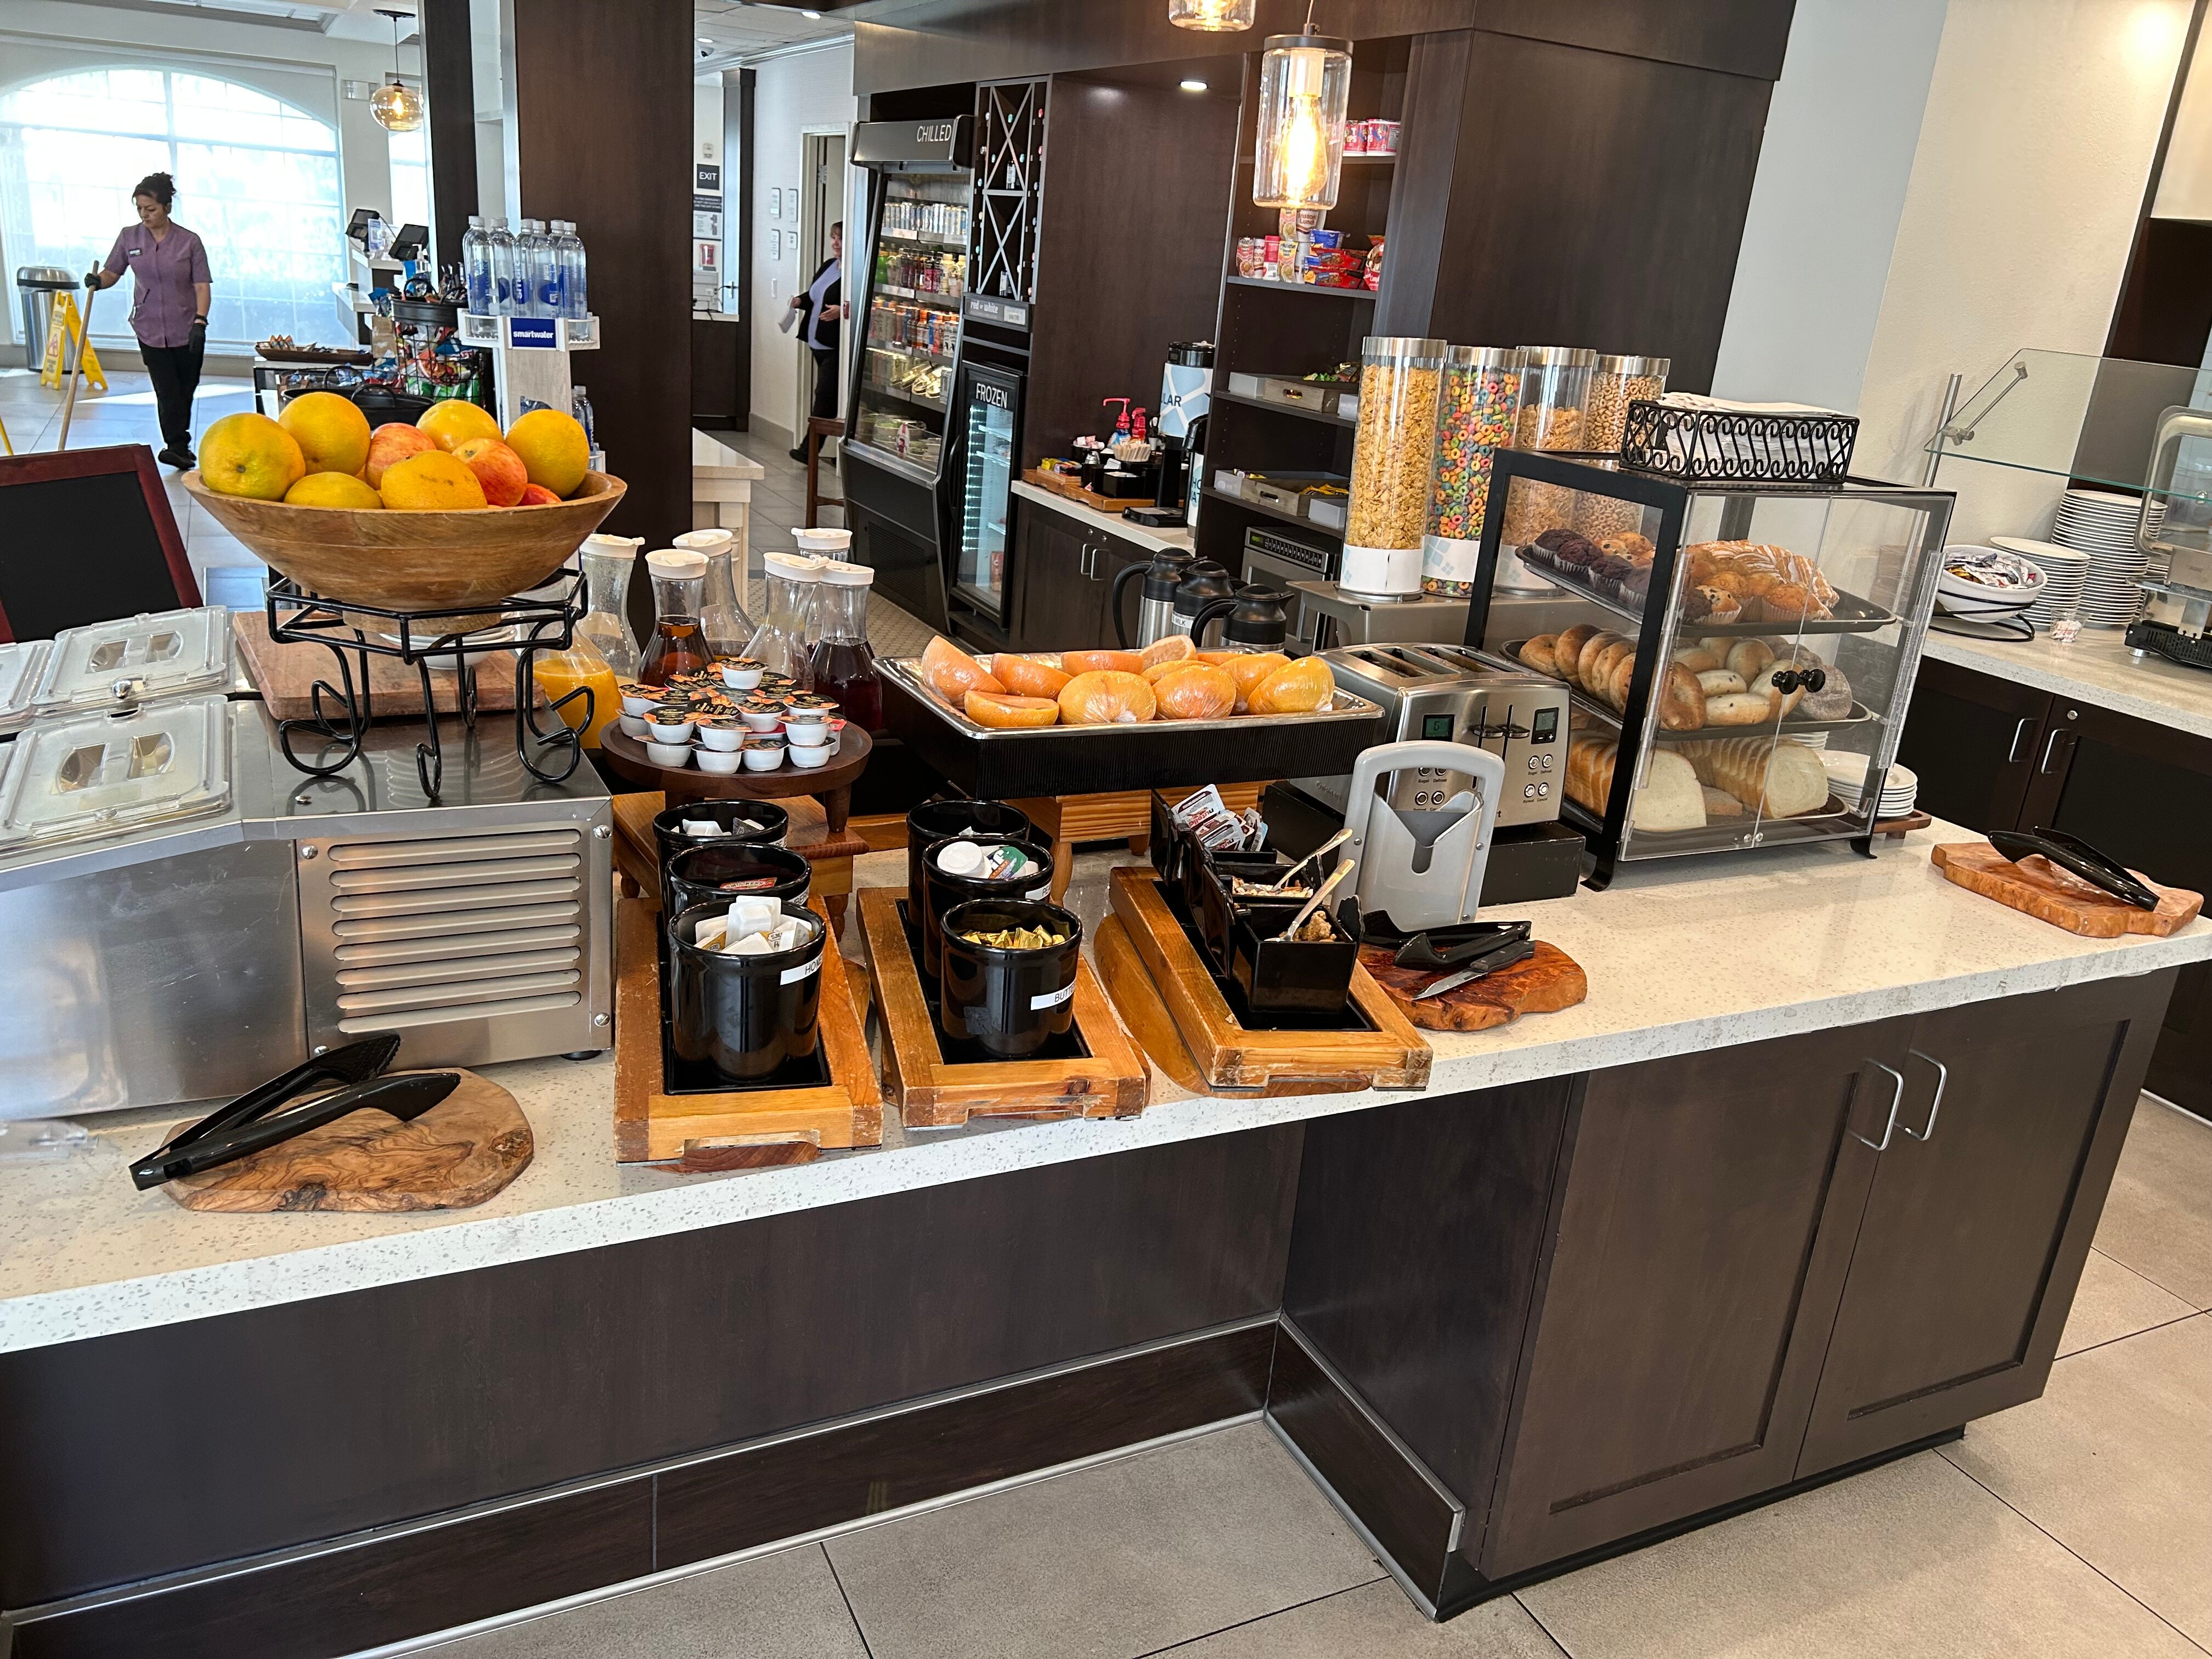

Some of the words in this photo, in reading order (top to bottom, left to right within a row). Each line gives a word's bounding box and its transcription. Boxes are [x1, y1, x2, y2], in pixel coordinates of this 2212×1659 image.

[916, 124, 952, 142] CHILLED
[699, 171, 718, 181] EXIT
[984, 302, 998, 314] white
[513, 330, 554, 339] smartwater
[975, 383, 1008, 409] FROZEN
[1188, 808, 1215, 827] nutella
